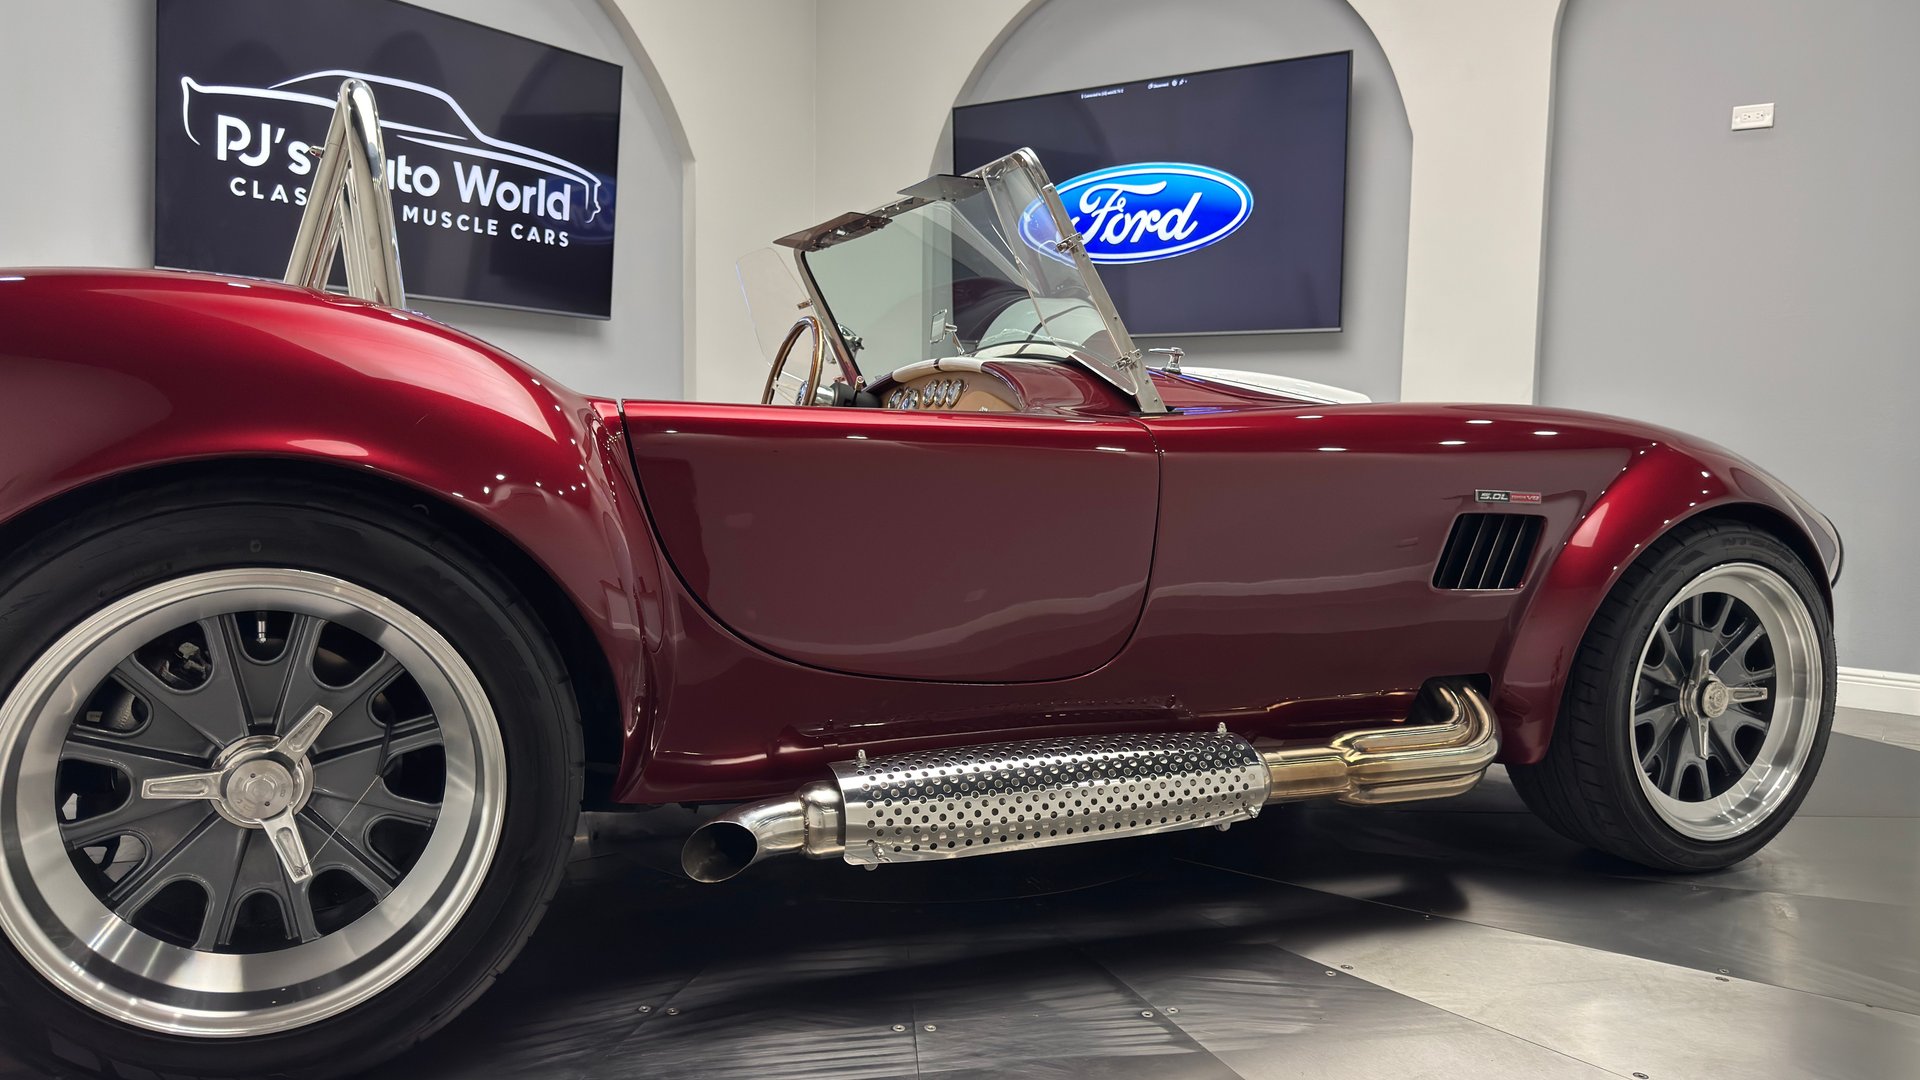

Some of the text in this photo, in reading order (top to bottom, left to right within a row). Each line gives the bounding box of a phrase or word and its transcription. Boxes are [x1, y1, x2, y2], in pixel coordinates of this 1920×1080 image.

[216, 114, 311, 175] PJ's
[453, 161, 571, 221] World
[230, 177, 569, 247] CLAS MUSCLE CARS
[1056, 180, 1203, 245] Ford
